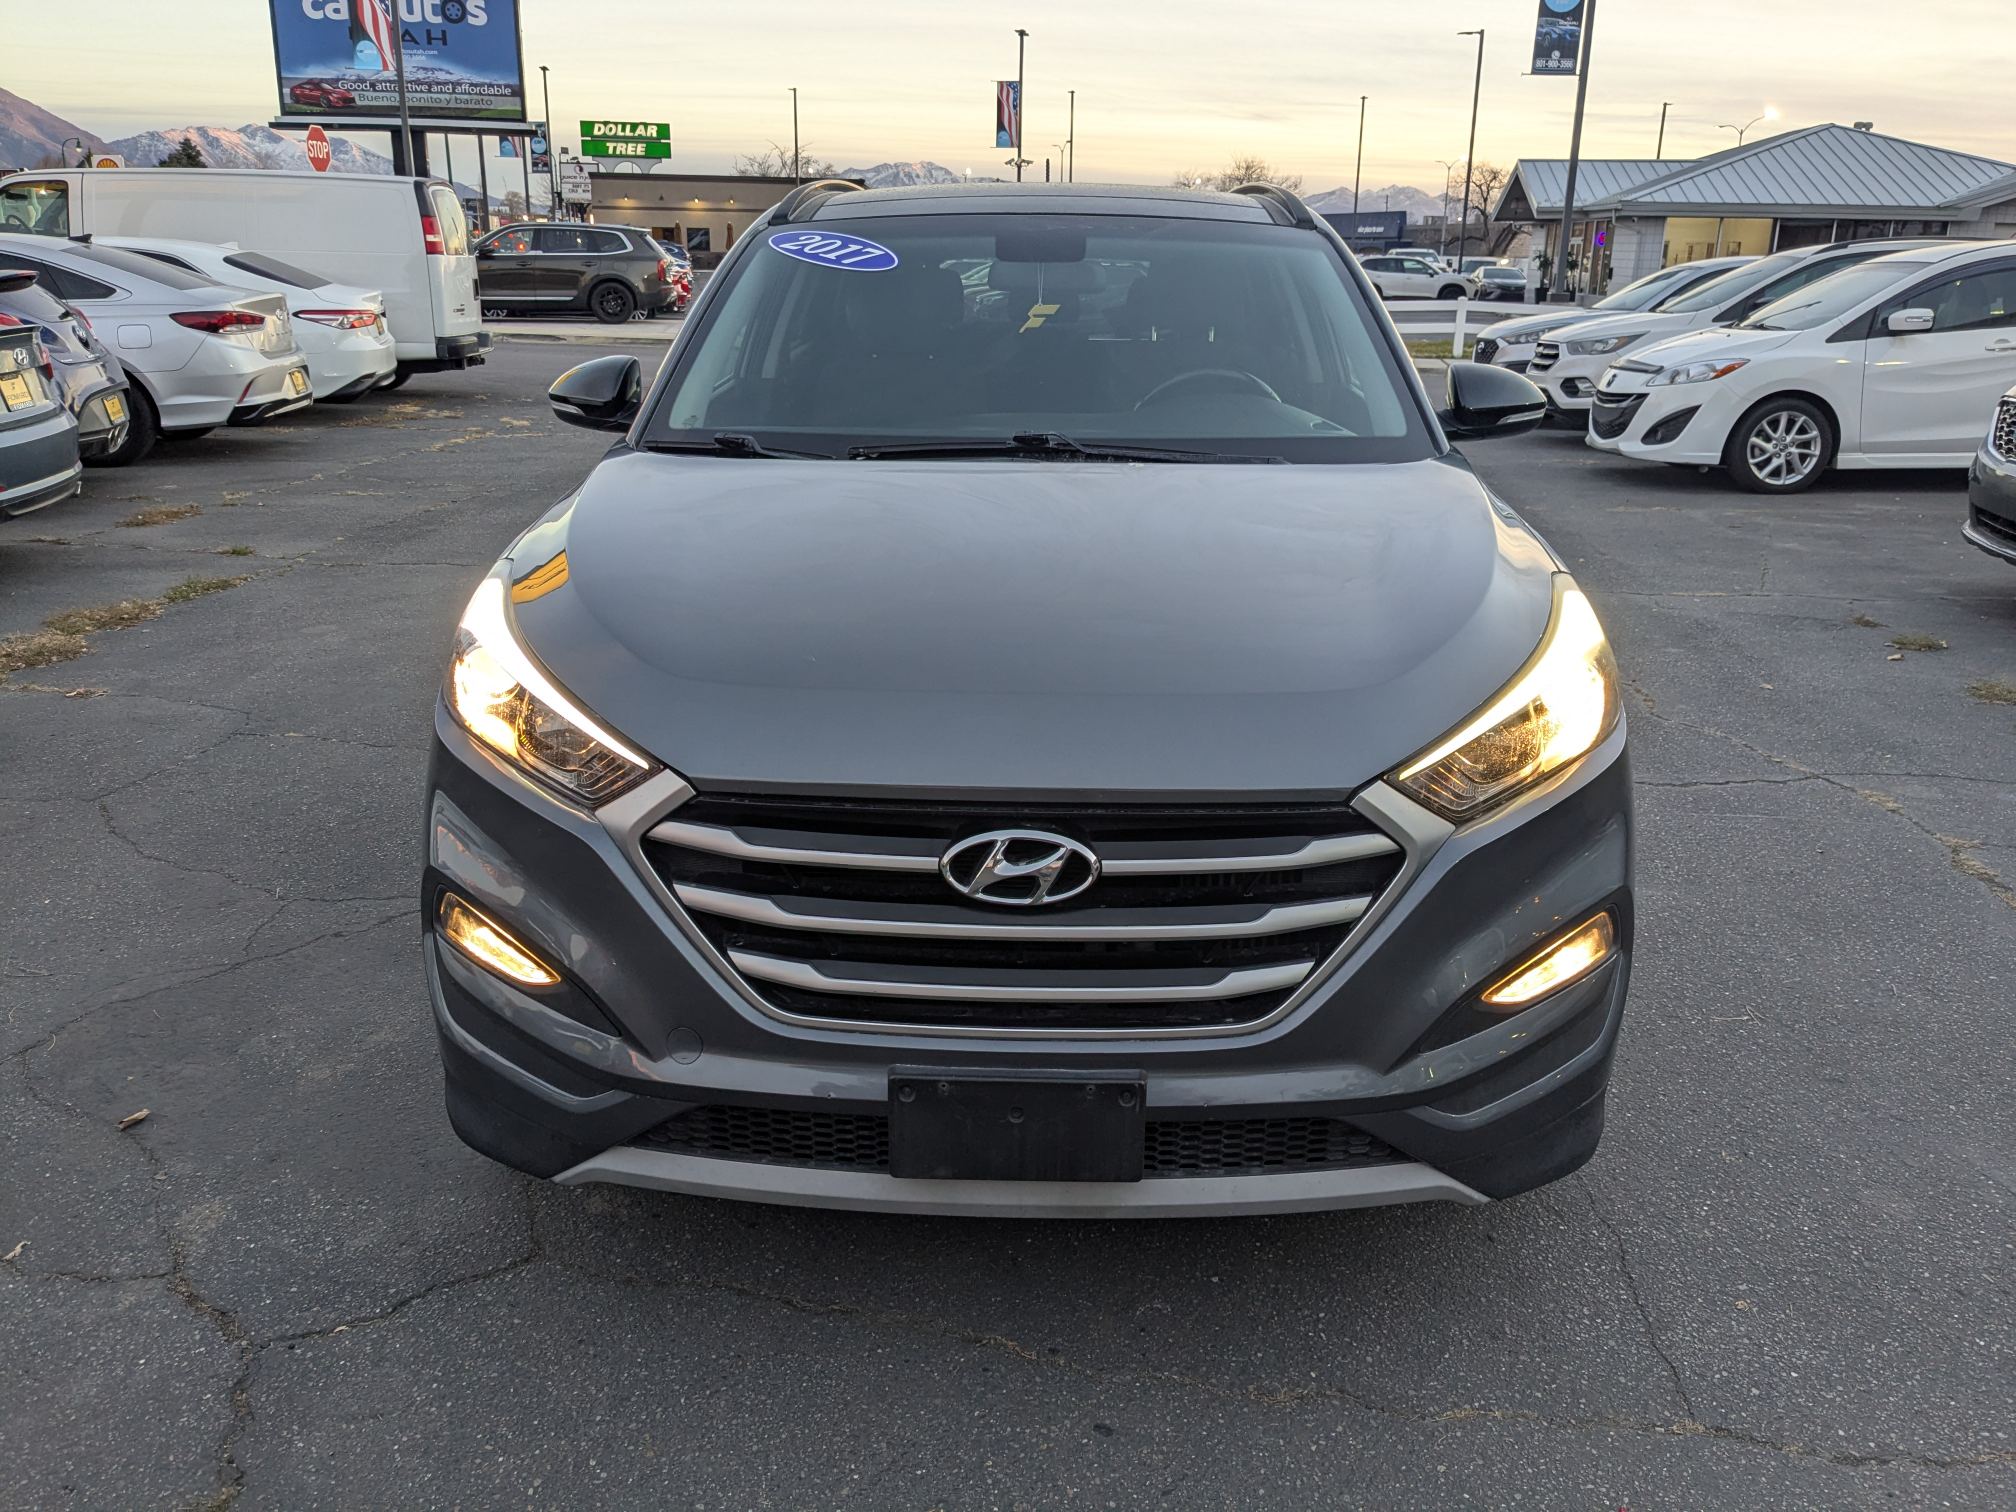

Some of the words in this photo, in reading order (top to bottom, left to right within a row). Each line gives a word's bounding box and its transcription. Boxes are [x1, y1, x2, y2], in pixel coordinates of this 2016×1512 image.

[338, 80, 373, 91] Good,
[375, 82, 429, 92] attrative
[431, 83, 453, 93] and
[455, 83, 512, 95] affordable
[444, 97, 452, 106] y
[455, 95, 493, 106] barato
[593, 123, 658, 137] DOLLAR
[307, 136, 329, 158] STOP
[606, 142, 647, 156] TREE
[778, 235, 887, 264] 2017
